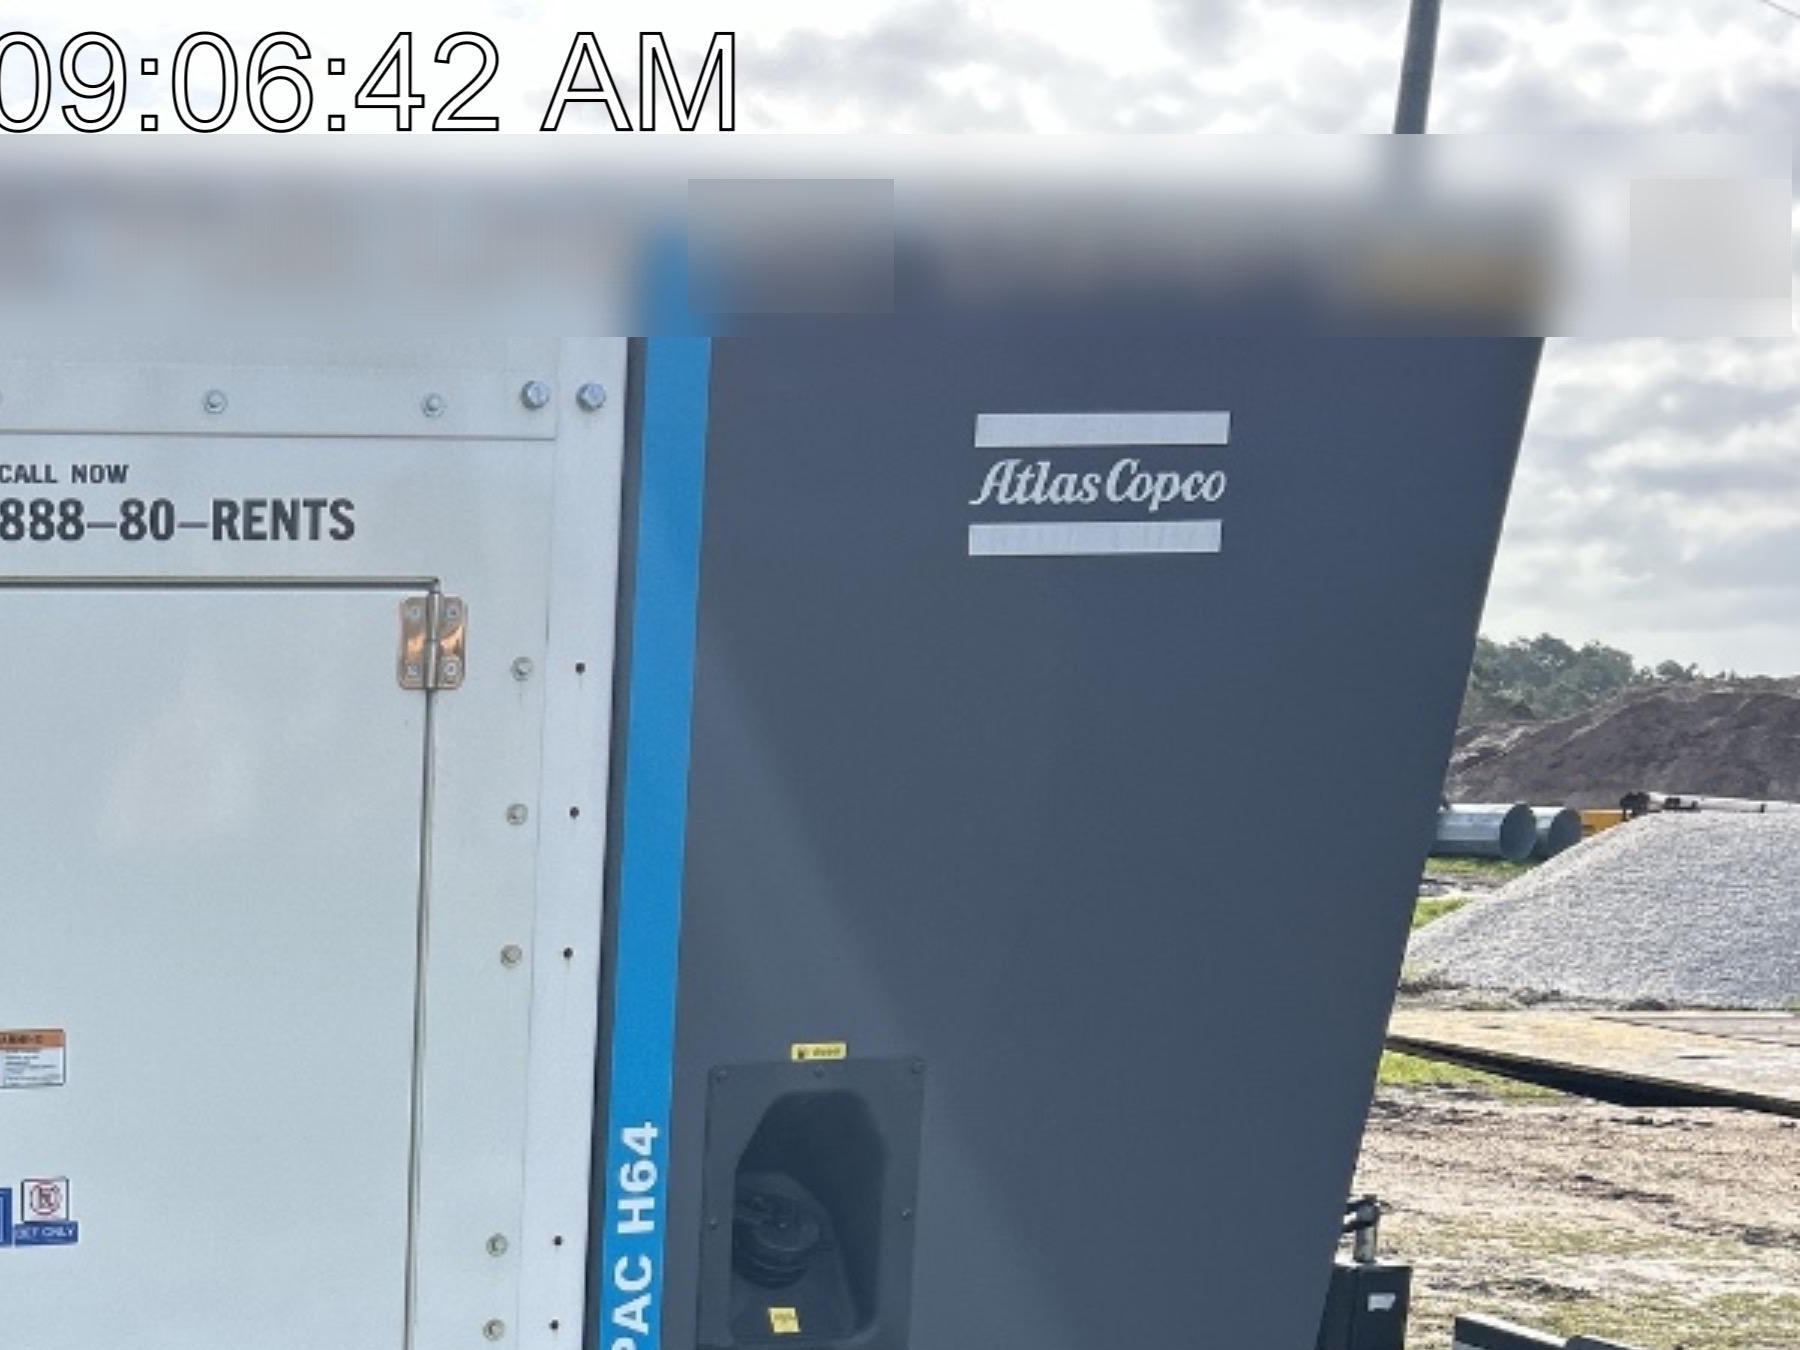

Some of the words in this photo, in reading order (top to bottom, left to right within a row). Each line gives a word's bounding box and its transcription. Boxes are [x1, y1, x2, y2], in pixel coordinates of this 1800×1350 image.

[71, 463, 129, 484] NOW
[968, 458, 1102, 506] Atlas
[1105, 457, 1227, 513] Copco
[616, 1121, 659, 1235] H64
